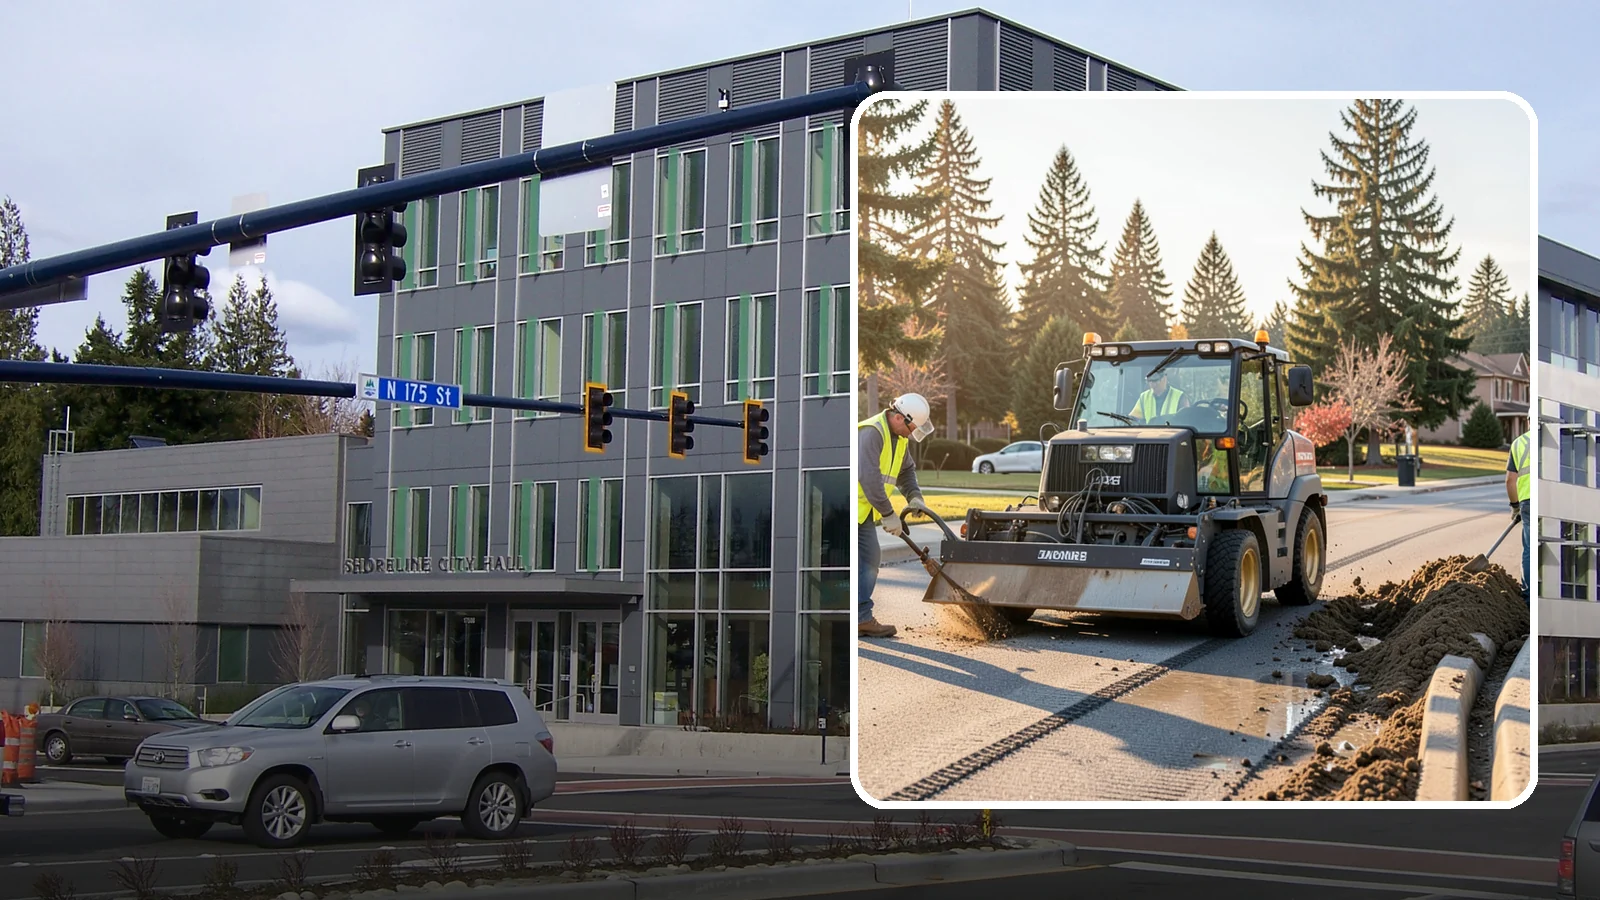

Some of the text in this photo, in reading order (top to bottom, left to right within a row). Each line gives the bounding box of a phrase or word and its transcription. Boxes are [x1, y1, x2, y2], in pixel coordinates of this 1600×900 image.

[387, 380, 451, 406] N 175 St
[344, 555, 526, 575] SHORELINE CITY HALL
